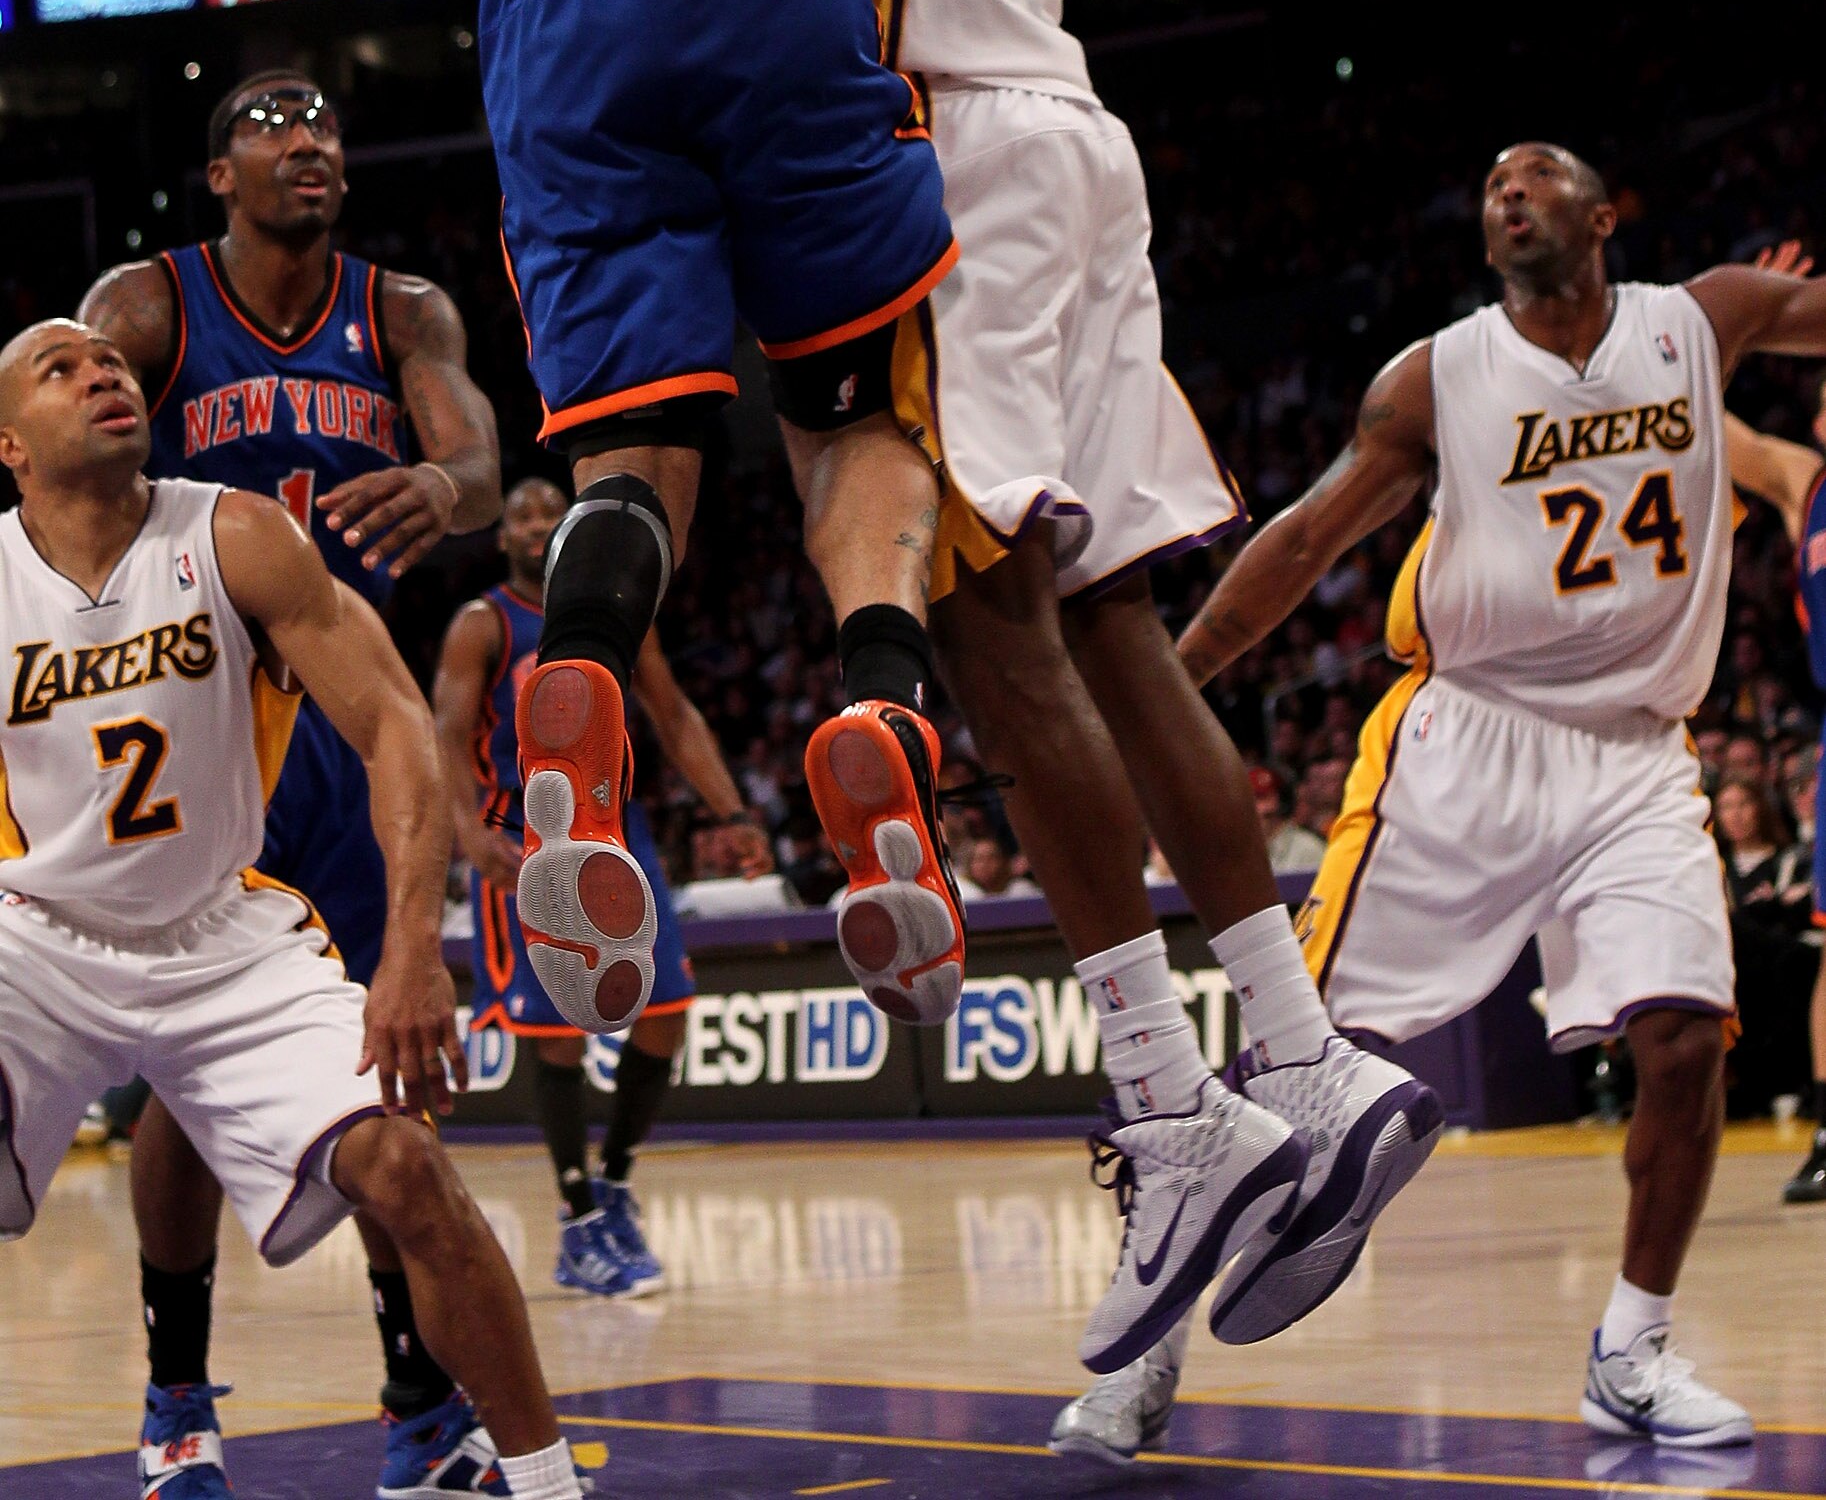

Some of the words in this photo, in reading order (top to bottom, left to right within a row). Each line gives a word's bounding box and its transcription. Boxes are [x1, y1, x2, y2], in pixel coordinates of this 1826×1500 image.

[183, 375, 279, 459] NEW
[281, 377, 401, 463] YORK
[1498, 395, 1695, 488] LAKERS
[277, 468, 316, 537] 1
[1538, 467, 1690, 597] 24
[6, 612, 218, 727] LAKERS
[90, 711, 184, 846] 2
